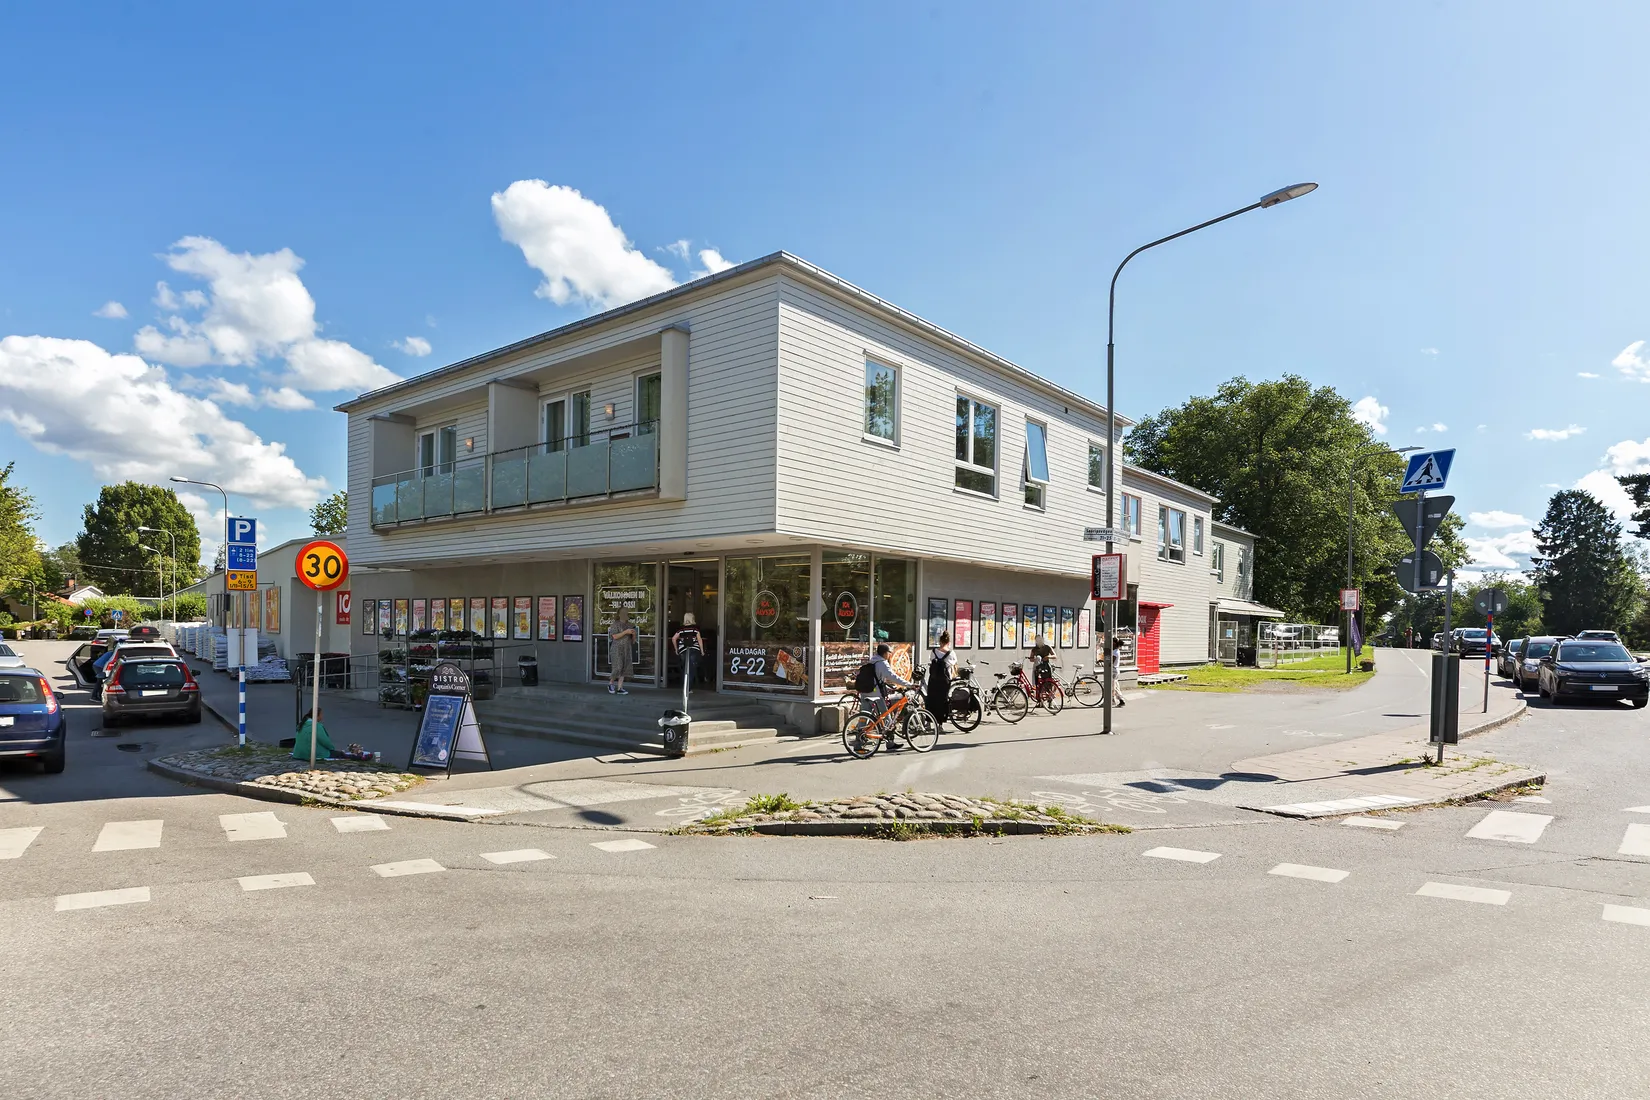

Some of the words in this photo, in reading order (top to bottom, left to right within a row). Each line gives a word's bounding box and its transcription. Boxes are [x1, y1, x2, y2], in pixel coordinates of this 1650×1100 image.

[235, 520, 251, 541] P
[306, 553, 341, 579] 30
[603, 590, 637, 599] VÄLKOMMEN
